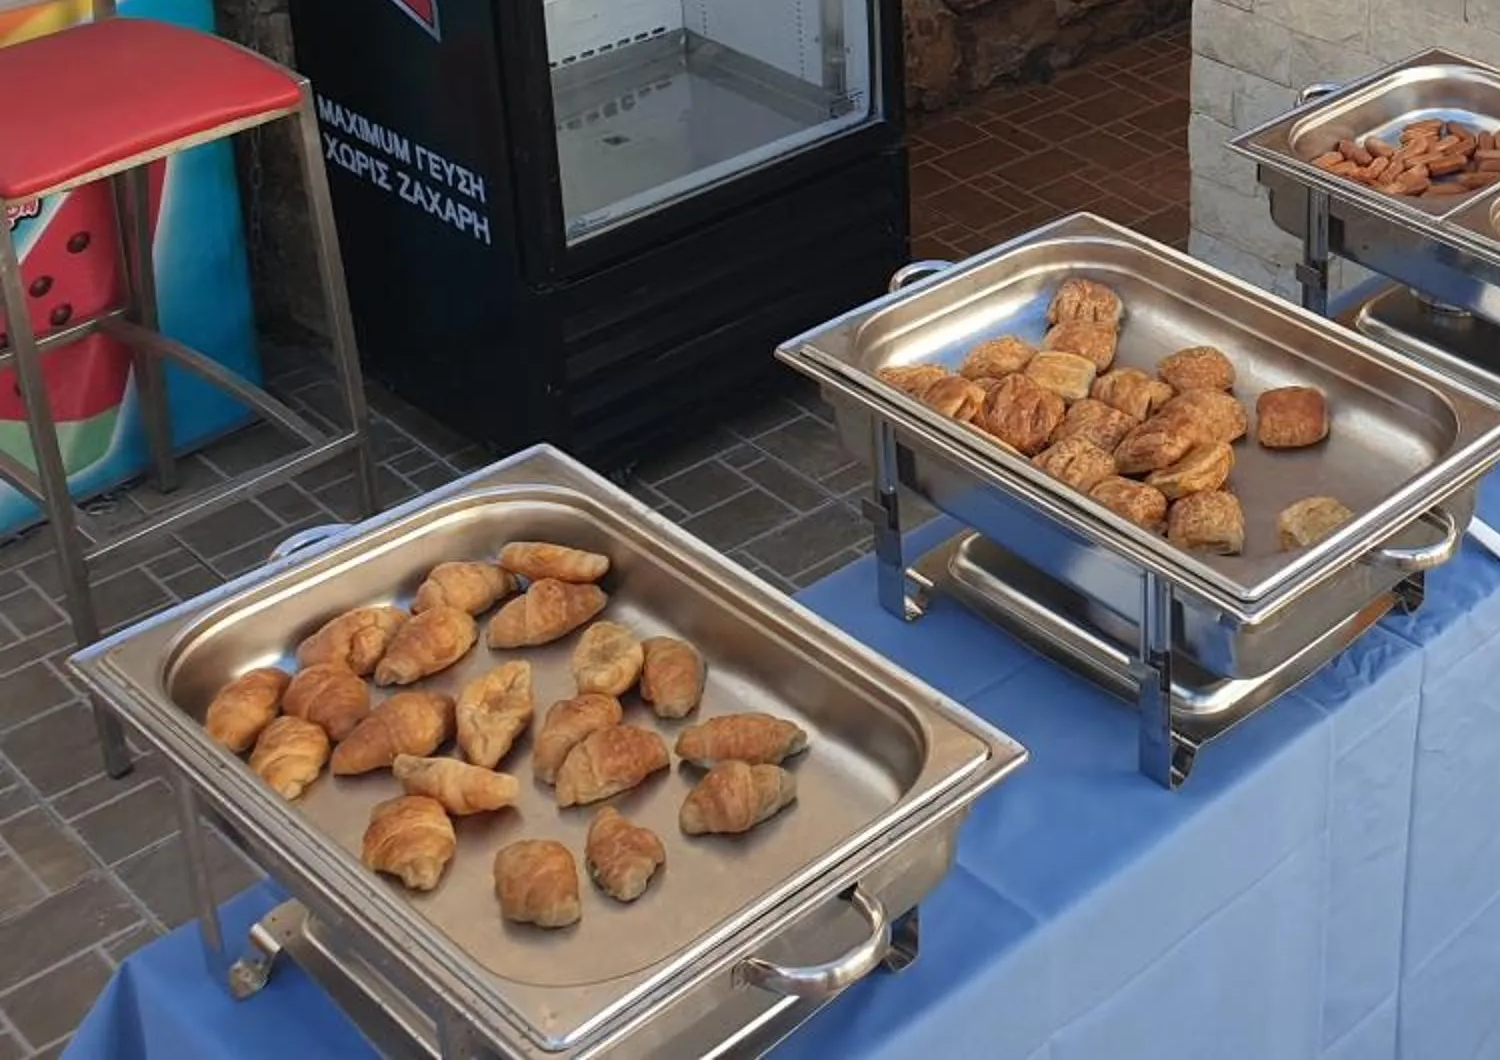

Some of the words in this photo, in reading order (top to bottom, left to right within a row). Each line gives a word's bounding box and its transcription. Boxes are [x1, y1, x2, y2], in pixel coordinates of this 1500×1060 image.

[323, 131, 393, 191] ΧΩΡΙΣ
[397, 171, 491, 245] ΖΑΧΑΡΗ
[415, 143, 487, 204] ΓΕΥΣΗ
